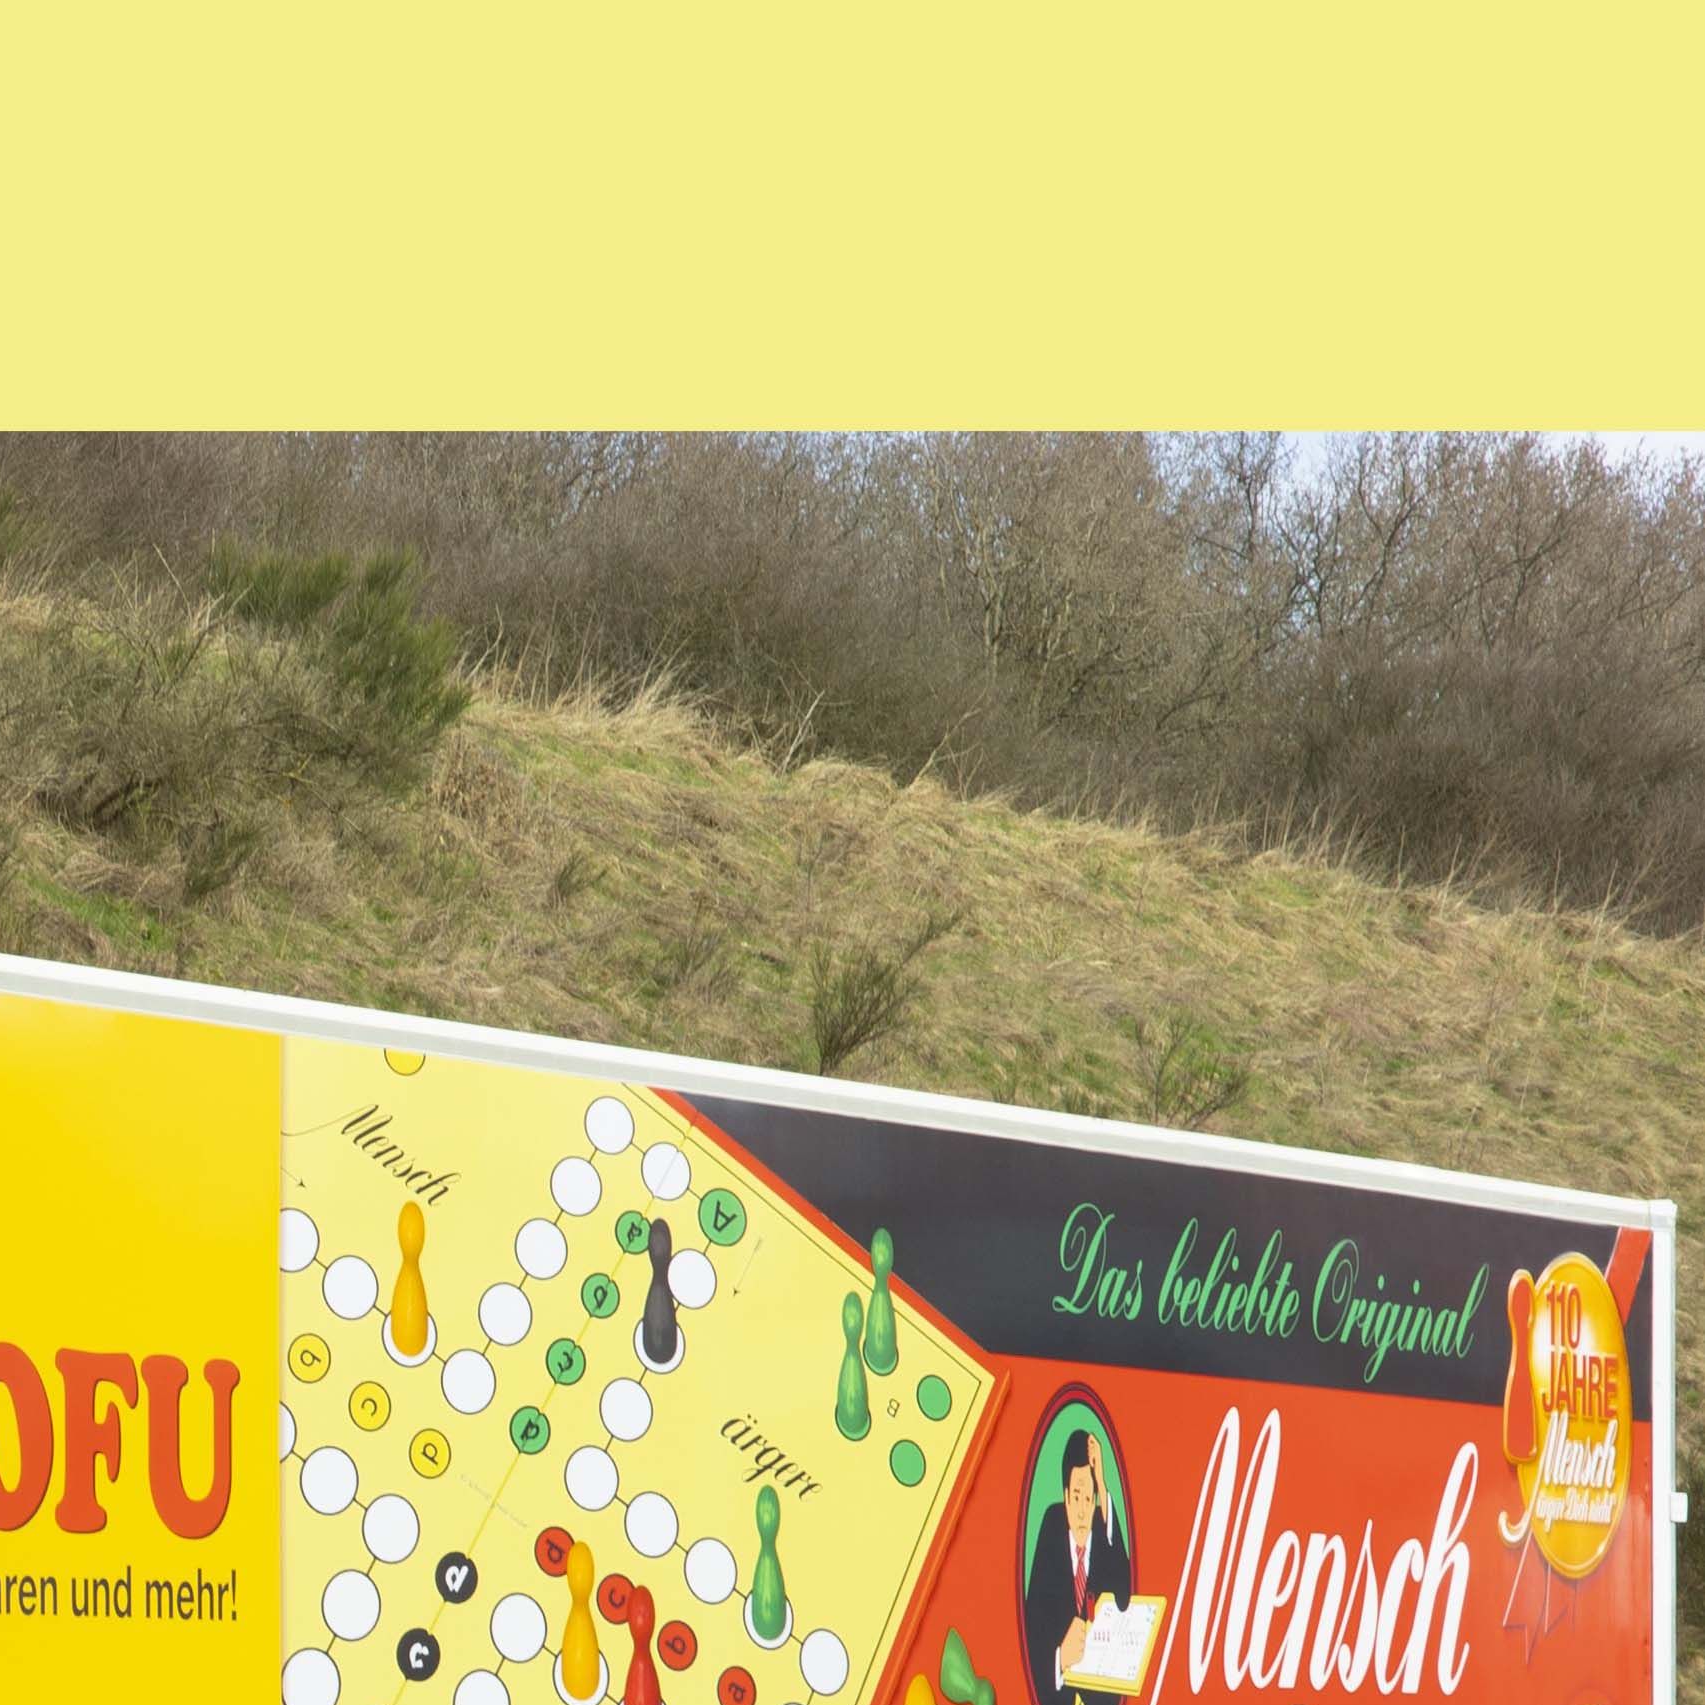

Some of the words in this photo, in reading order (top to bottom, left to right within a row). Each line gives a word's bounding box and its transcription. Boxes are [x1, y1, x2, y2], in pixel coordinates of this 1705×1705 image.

[281, 1104, 461, 1207] Mensch
[1052, 1202, 1144, 1321] Das
[1157, 1218, 1301, 1338] beliebte
[1311, 1239, 1489, 1384] Original
[1545, 1283, 1582, 1350] 110
[1542, 1350, 1618, 1417] JAHRE
[719, 1413, 823, 1501] ärgere
[70, 1565, 132, 1618] und
[145, 1568, 237, 1621] mehr!
